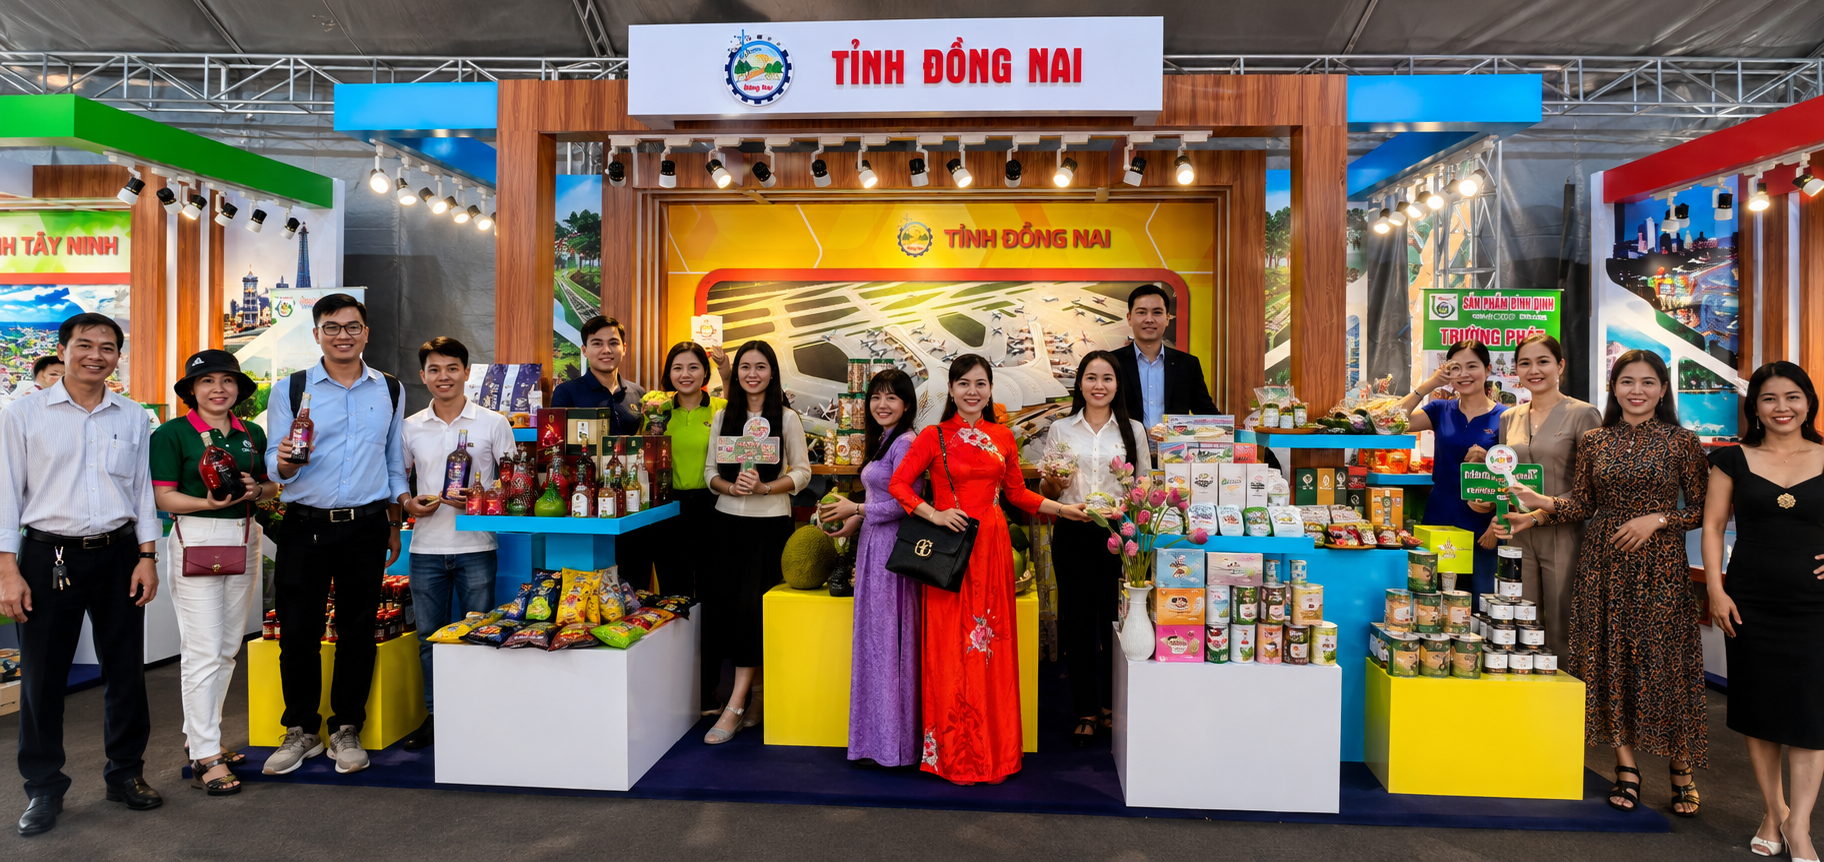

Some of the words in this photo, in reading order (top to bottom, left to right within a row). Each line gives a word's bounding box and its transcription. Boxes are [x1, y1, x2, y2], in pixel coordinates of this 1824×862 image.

[831, 38, 905, 86] TỈNH
[922, 36, 1012, 84] ĐỒNG
[1028, 47, 1083, 84] NAI
[66, 236, 119, 256] NINH
[944, 223, 998, 249] TỈNH
[1072, 228, 1112, 249] NAI
